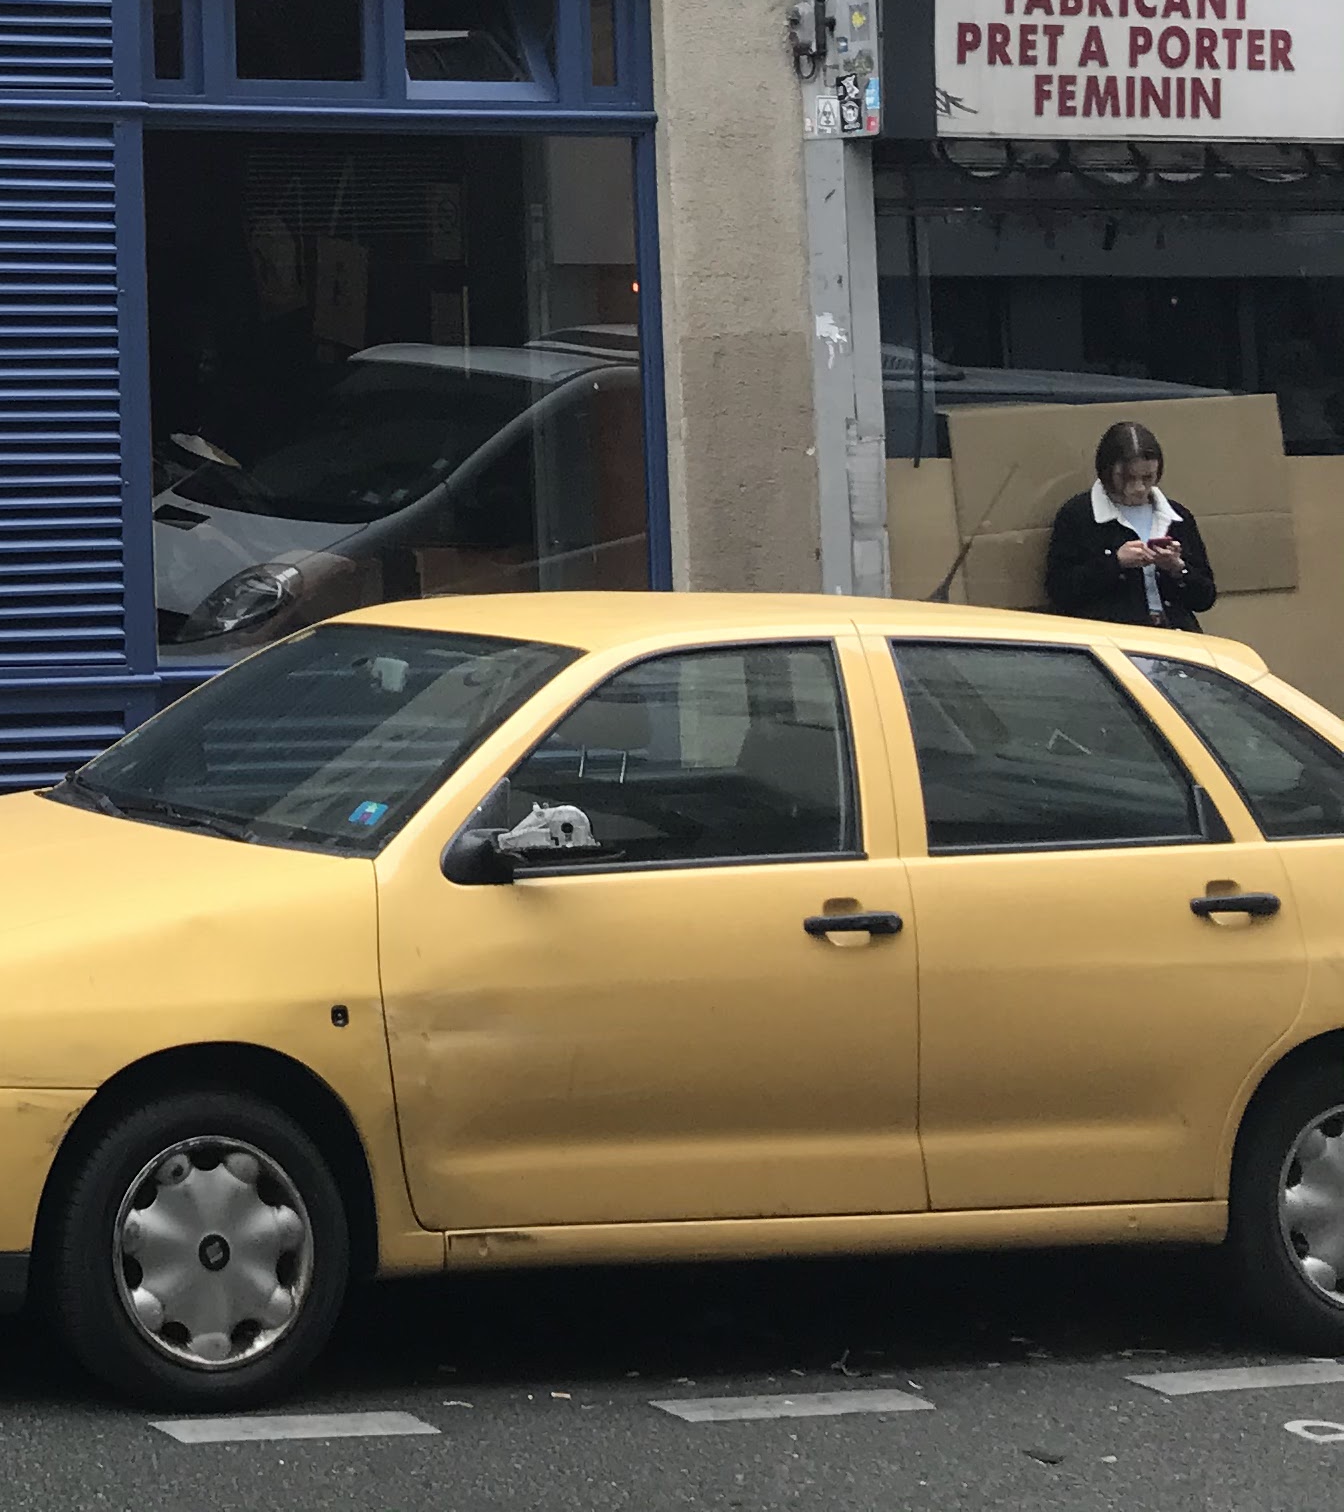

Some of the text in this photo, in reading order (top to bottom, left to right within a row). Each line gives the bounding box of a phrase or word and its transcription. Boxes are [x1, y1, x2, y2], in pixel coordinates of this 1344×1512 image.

[957, 22, 1295, 71] PRET A PORTER
[1034, 74, 1221, 119] FEMININ
